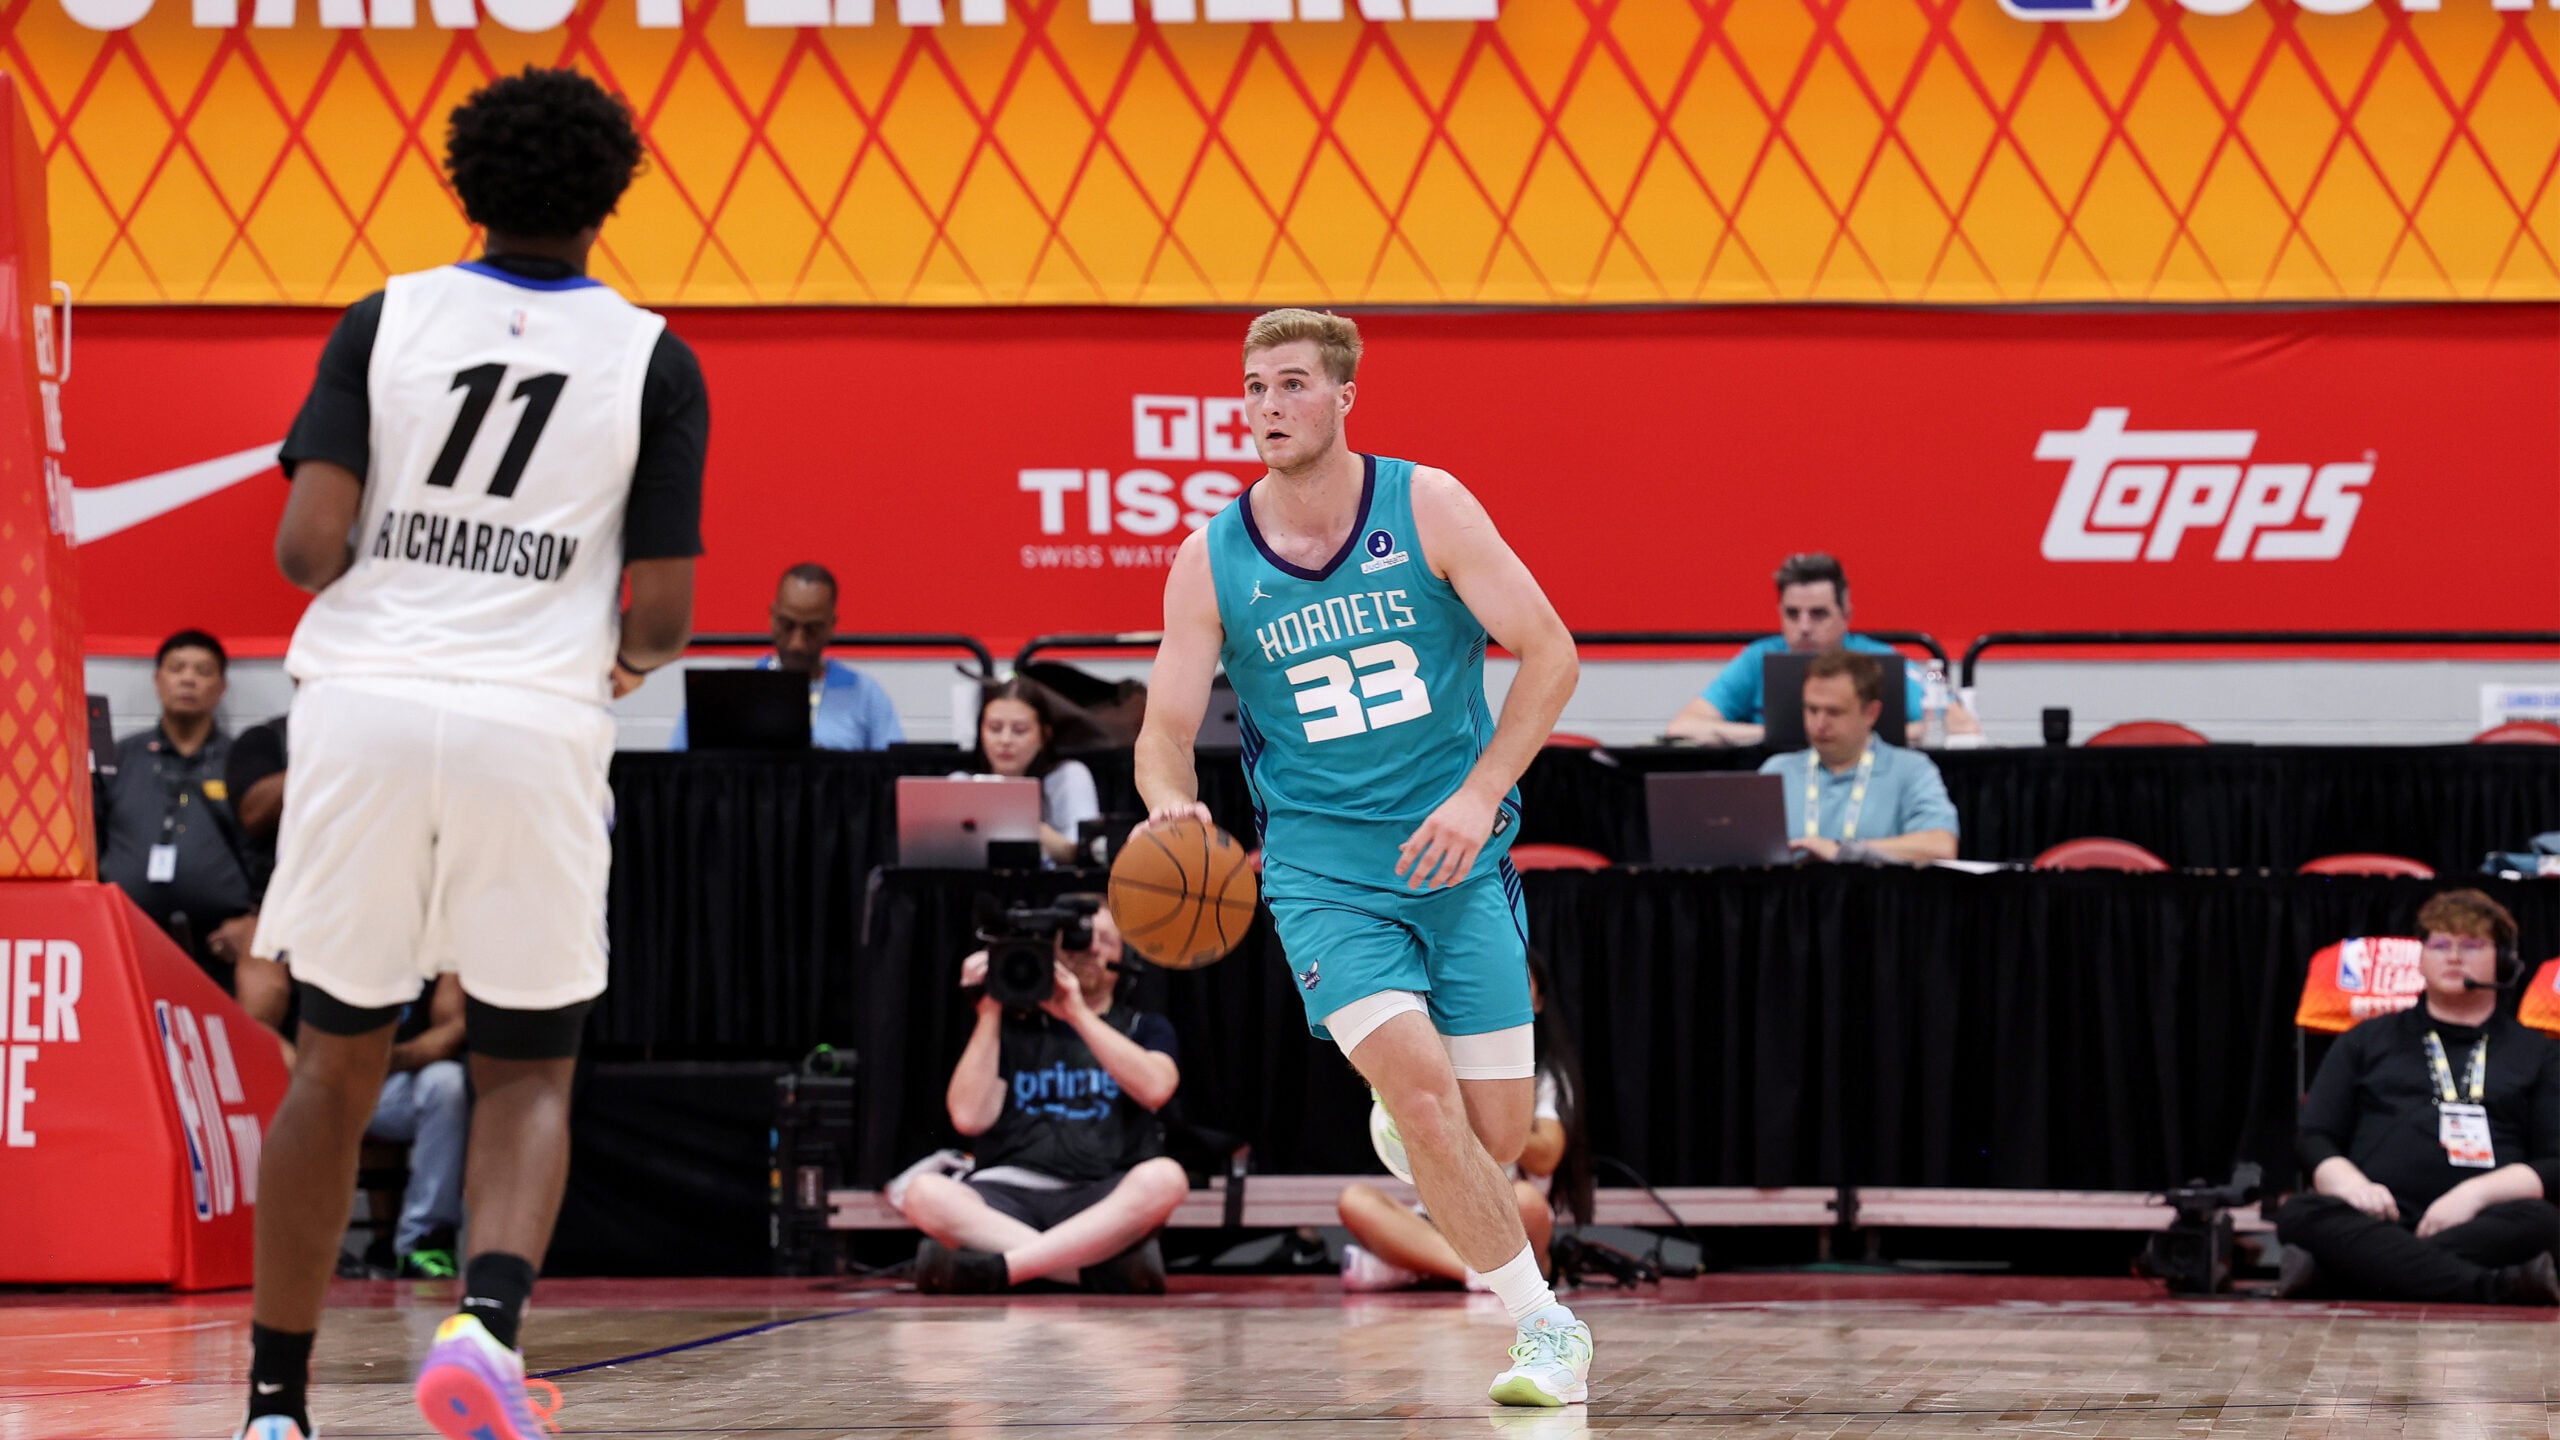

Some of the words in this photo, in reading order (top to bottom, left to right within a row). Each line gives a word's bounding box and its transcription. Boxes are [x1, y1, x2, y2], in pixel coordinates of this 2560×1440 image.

[426, 362, 569, 499] 11
[1018, 468, 1243, 537] TISS
[1020, 544, 1104, 569] SWISS
[1108, 544, 1181, 569] WATC
[1256, 589, 1417, 663] HORNETS
[1284, 640, 1433, 743] 33
